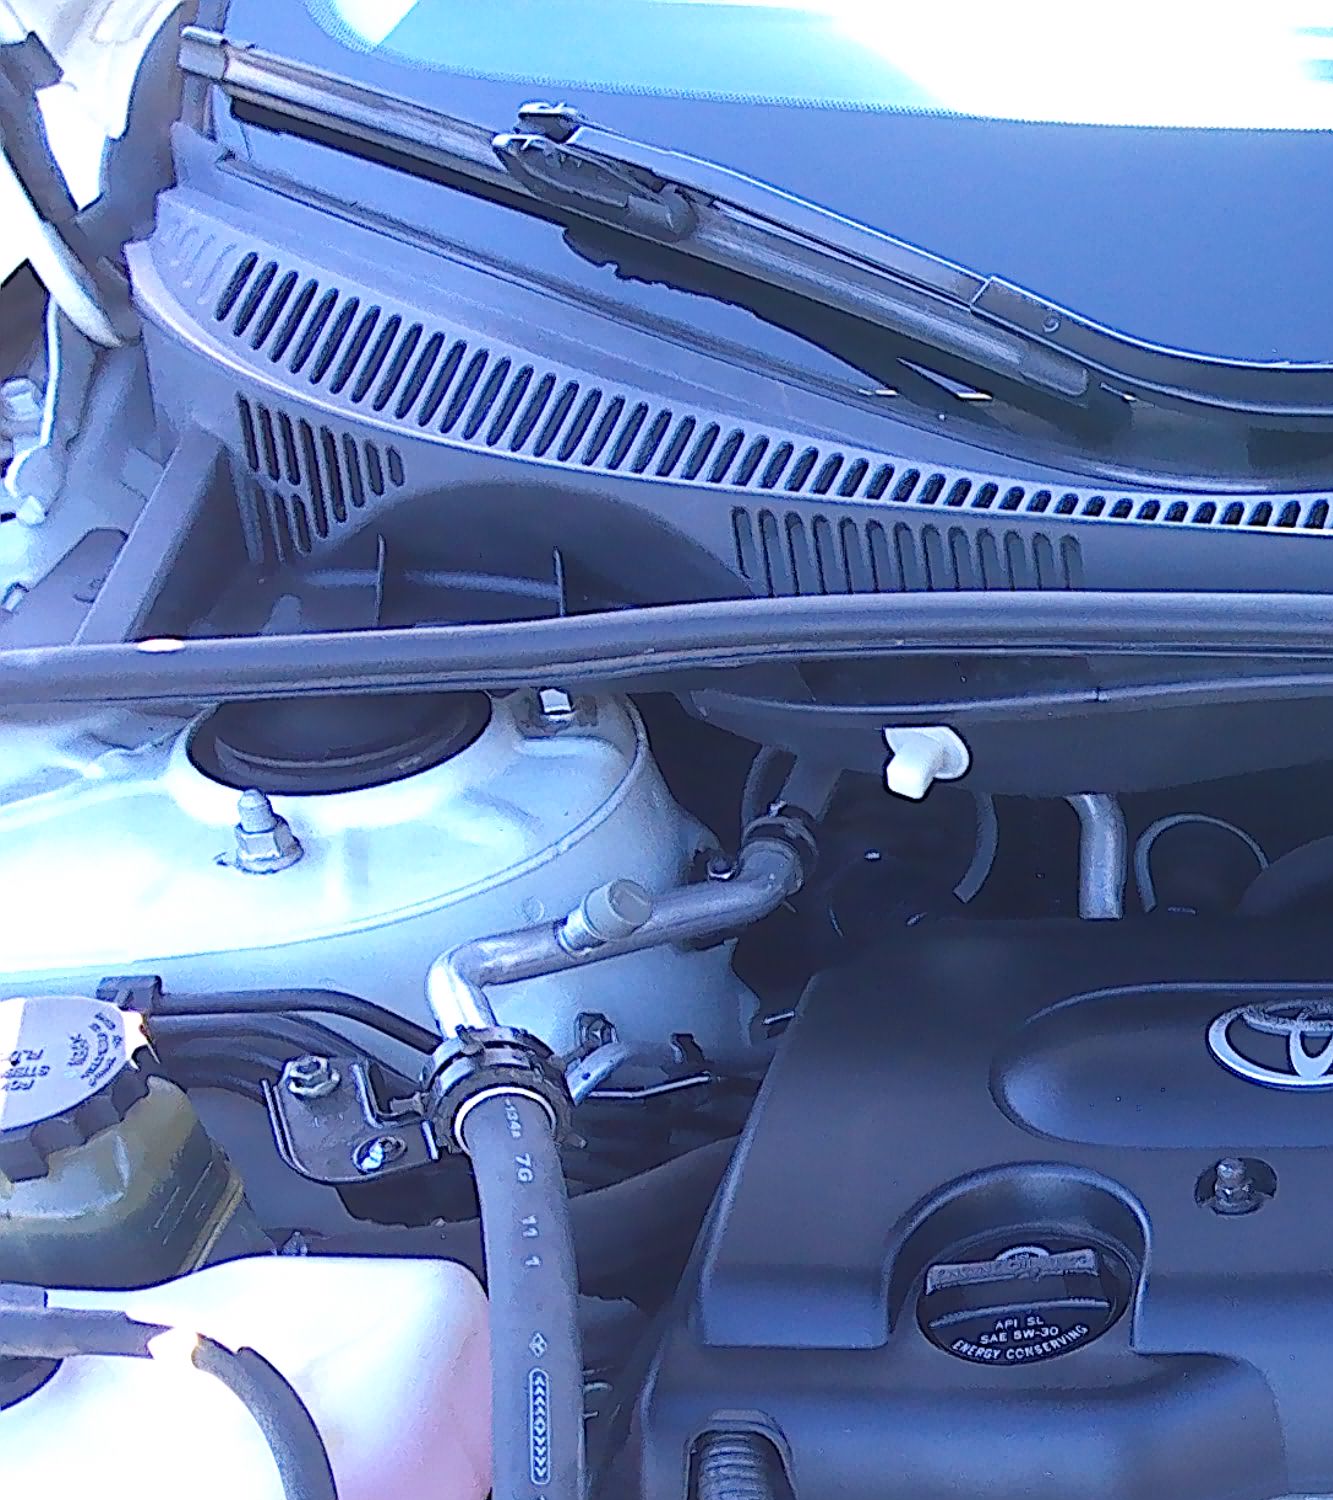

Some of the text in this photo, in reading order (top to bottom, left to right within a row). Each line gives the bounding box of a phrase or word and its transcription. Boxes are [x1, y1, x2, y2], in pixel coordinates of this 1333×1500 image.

[994, 1318, 1017, 1330] API
[951, 1324, 1089, 1359] ENERGY CONSERVING
[979, 1326, 1059, 1344] SAE 5W-30
